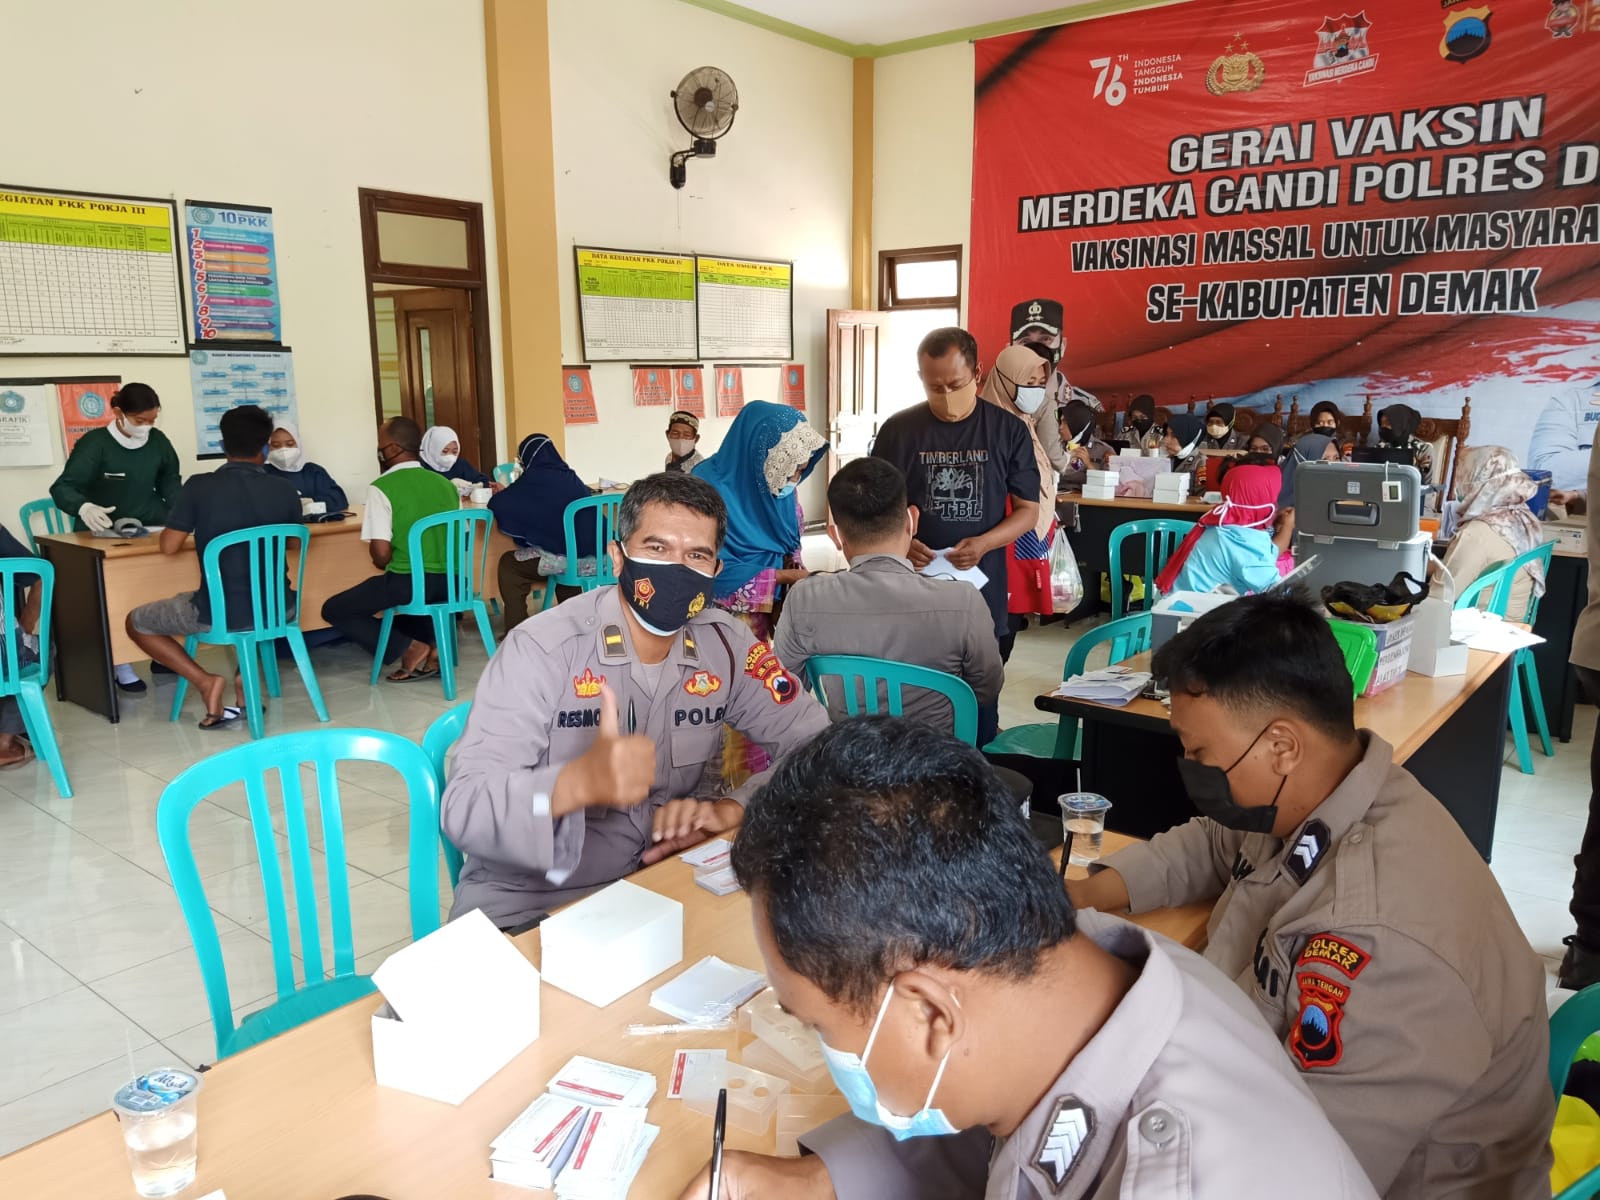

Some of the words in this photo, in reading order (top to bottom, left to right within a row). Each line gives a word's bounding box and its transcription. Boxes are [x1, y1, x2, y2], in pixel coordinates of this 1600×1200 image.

[1134, 54, 1182, 68] INDONESIA
[1134, 65, 1174, 77] TANGGUH
[1089, 57, 1127, 106] 76
[1118, 53, 1129, 62] TH
[1133, 73, 1183, 86] INDONESIA
[1133, 84, 1169, 95] TUMBUH
[1169, 122, 1315, 173] GERAI
[1328, 95, 1545, 158] VAKSIN
[1020, 180, 1197, 232] MERDEKA
[1207, 166, 1340, 215] CANDI
[1350, 148, 1547, 205] POLRES
[58, 200, 86, 210] PKK
[90, 203, 128, 214] POKJA
[131, 206, 146, 215] III
[218, 211, 237, 224] 10
[238, 216, 268, 227] PKK
[1071, 233, 1197, 272] VAKSINASI
[1203, 225, 1315, 265] MASSAL
[1323, 216, 1428, 258] UNTUK
[1434, 204, 1600, 252] MASYARA
[192, 239, 204, 251] 2
[193, 249, 204, 261] 3
[194, 260, 204, 272] 4
[196, 271, 206, 282] 5
[196, 283, 206, 294] 6
[1147, 274, 1392, 322] SE-KABUPATEN
[1399, 268, 1541, 316] DEMAK
[198, 294, 208, 305] 7
[198, 305, 210, 317] 8
[200, 317, 211, 329] 9
[201, 328, 217, 339] 10
[0, 415, 28, 424] RAFIK
[919, 449, 989, 465] TIMBERLAND
[941, 500, 983, 521] TBL
[1304, 948, 1350, 970] DEMAK
[1316, 979, 1344, 998] TENGAH
